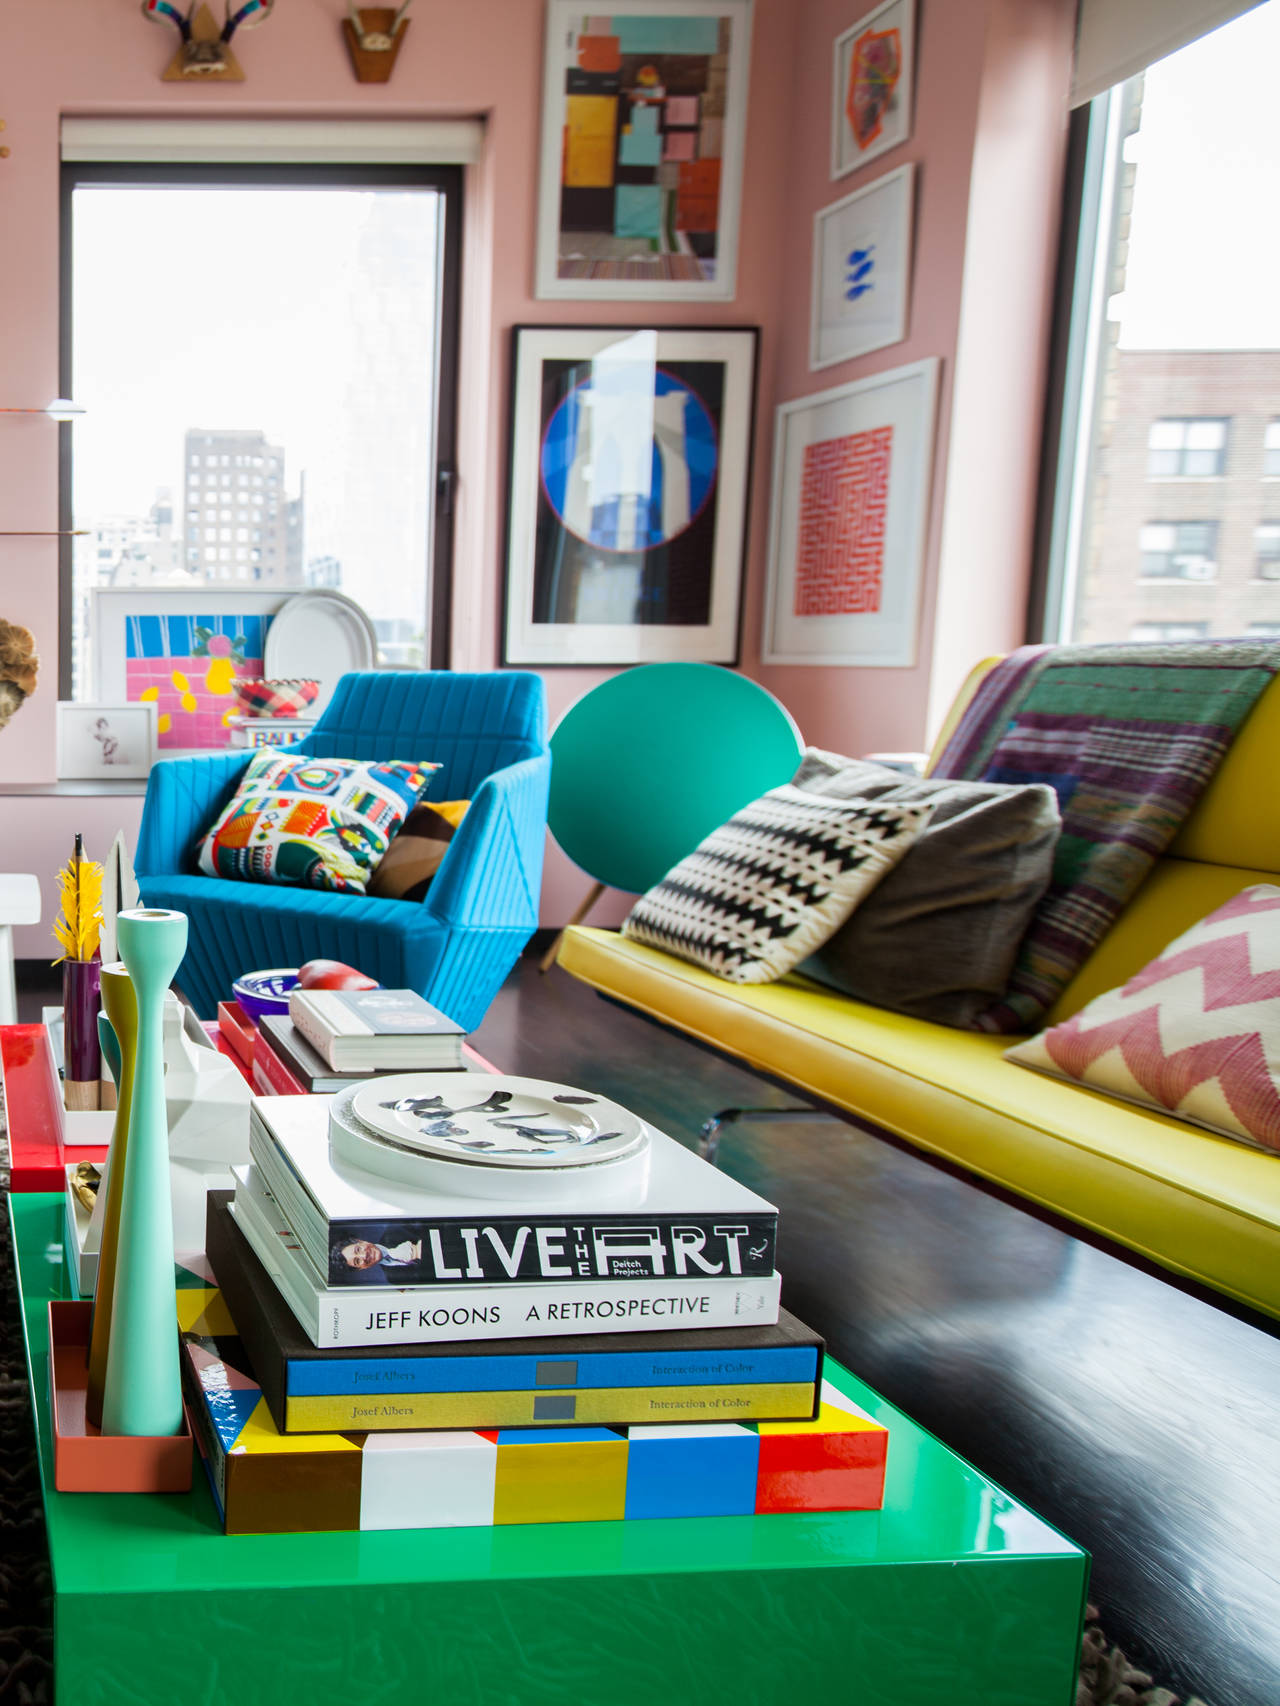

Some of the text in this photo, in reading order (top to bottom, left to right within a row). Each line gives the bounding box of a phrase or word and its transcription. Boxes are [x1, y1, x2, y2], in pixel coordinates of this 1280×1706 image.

[429, 1226, 572, 1279] LIVE
[612, 1260, 642, 1268] Deitch
[613, 1268, 649, 1277] Projects
[526, 1296, 710, 1321] A RETROSPECTIVE
[366, 1306, 500, 1330] JEFF KOONS
[650, 1398, 751, 1409] Interaction of Color
[351, 1406, 414, 1418] Josef Albers
